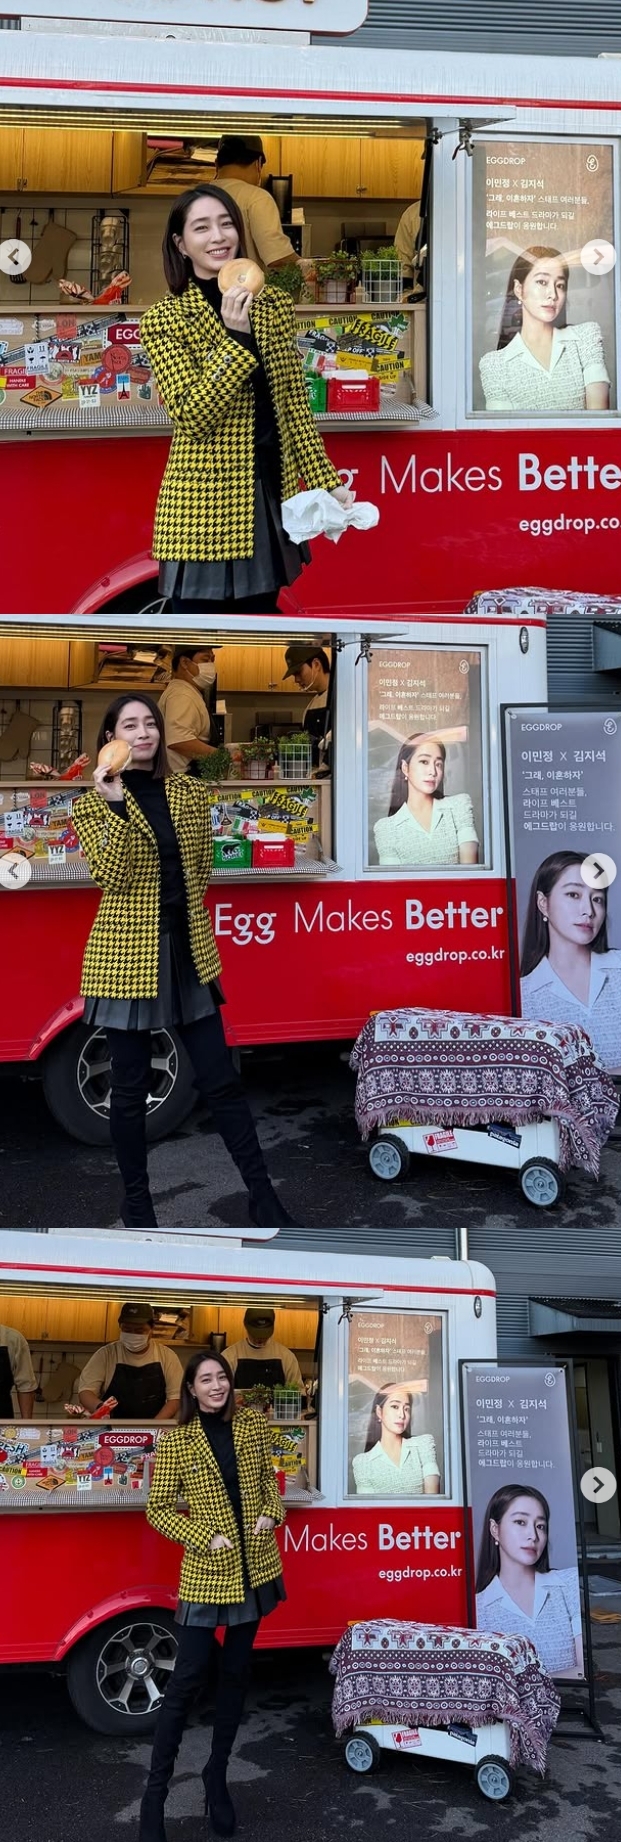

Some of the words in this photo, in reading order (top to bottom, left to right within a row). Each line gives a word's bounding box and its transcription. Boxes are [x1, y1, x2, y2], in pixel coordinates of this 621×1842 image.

[486, 156, 526, 165] EGGDROP
[512, 180, 518, 188] X
[520, 179, 544, 190] 김지석
[329, 314, 357, 325] CAUTION
[351, 319, 398, 350] FRAGILE
[80, 385, 98, 396] YYZ
[381, 452, 502, 494] Makes
[379, 661, 410, 669] EGGDROP
[522, 750, 553, 762] 이민정
[560, 751, 568, 761] X
[574, 750, 606, 762] 김지석
[547, 770, 584, 780] 이혼하자'
[522, 788, 548, 796] 스태프
[550, 787, 588, 797] 여러분들,
[523, 799, 548, 808] 라이프
[550, 799, 577, 808] 베스트
[524, 810, 557, 819] 드라마가
[560, 810, 577, 820] 되길
[524, 822, 566, 831] 에그드랍이
[569, 822, 616, 832] 응원합니다.
[215, 903, 276, 946] Egg
[295, 899, 393, 933] Makes
[406, 899, 504, 930] Better
[406, 946, 504, 966] eggdrop.co.kr
[476, 1399, 502, 1409] 이민정
[508, 1400, 514, 1408] X
[520, 1399, 546, 1409] 김지석
[104, 1436, 148, 1444] EGGDROP
[284, 1523, 368, 1552] Makes
[378, 1524, 461, 1550] Better
[379, 1565, 462, 1582] eggdrop.co.kr
